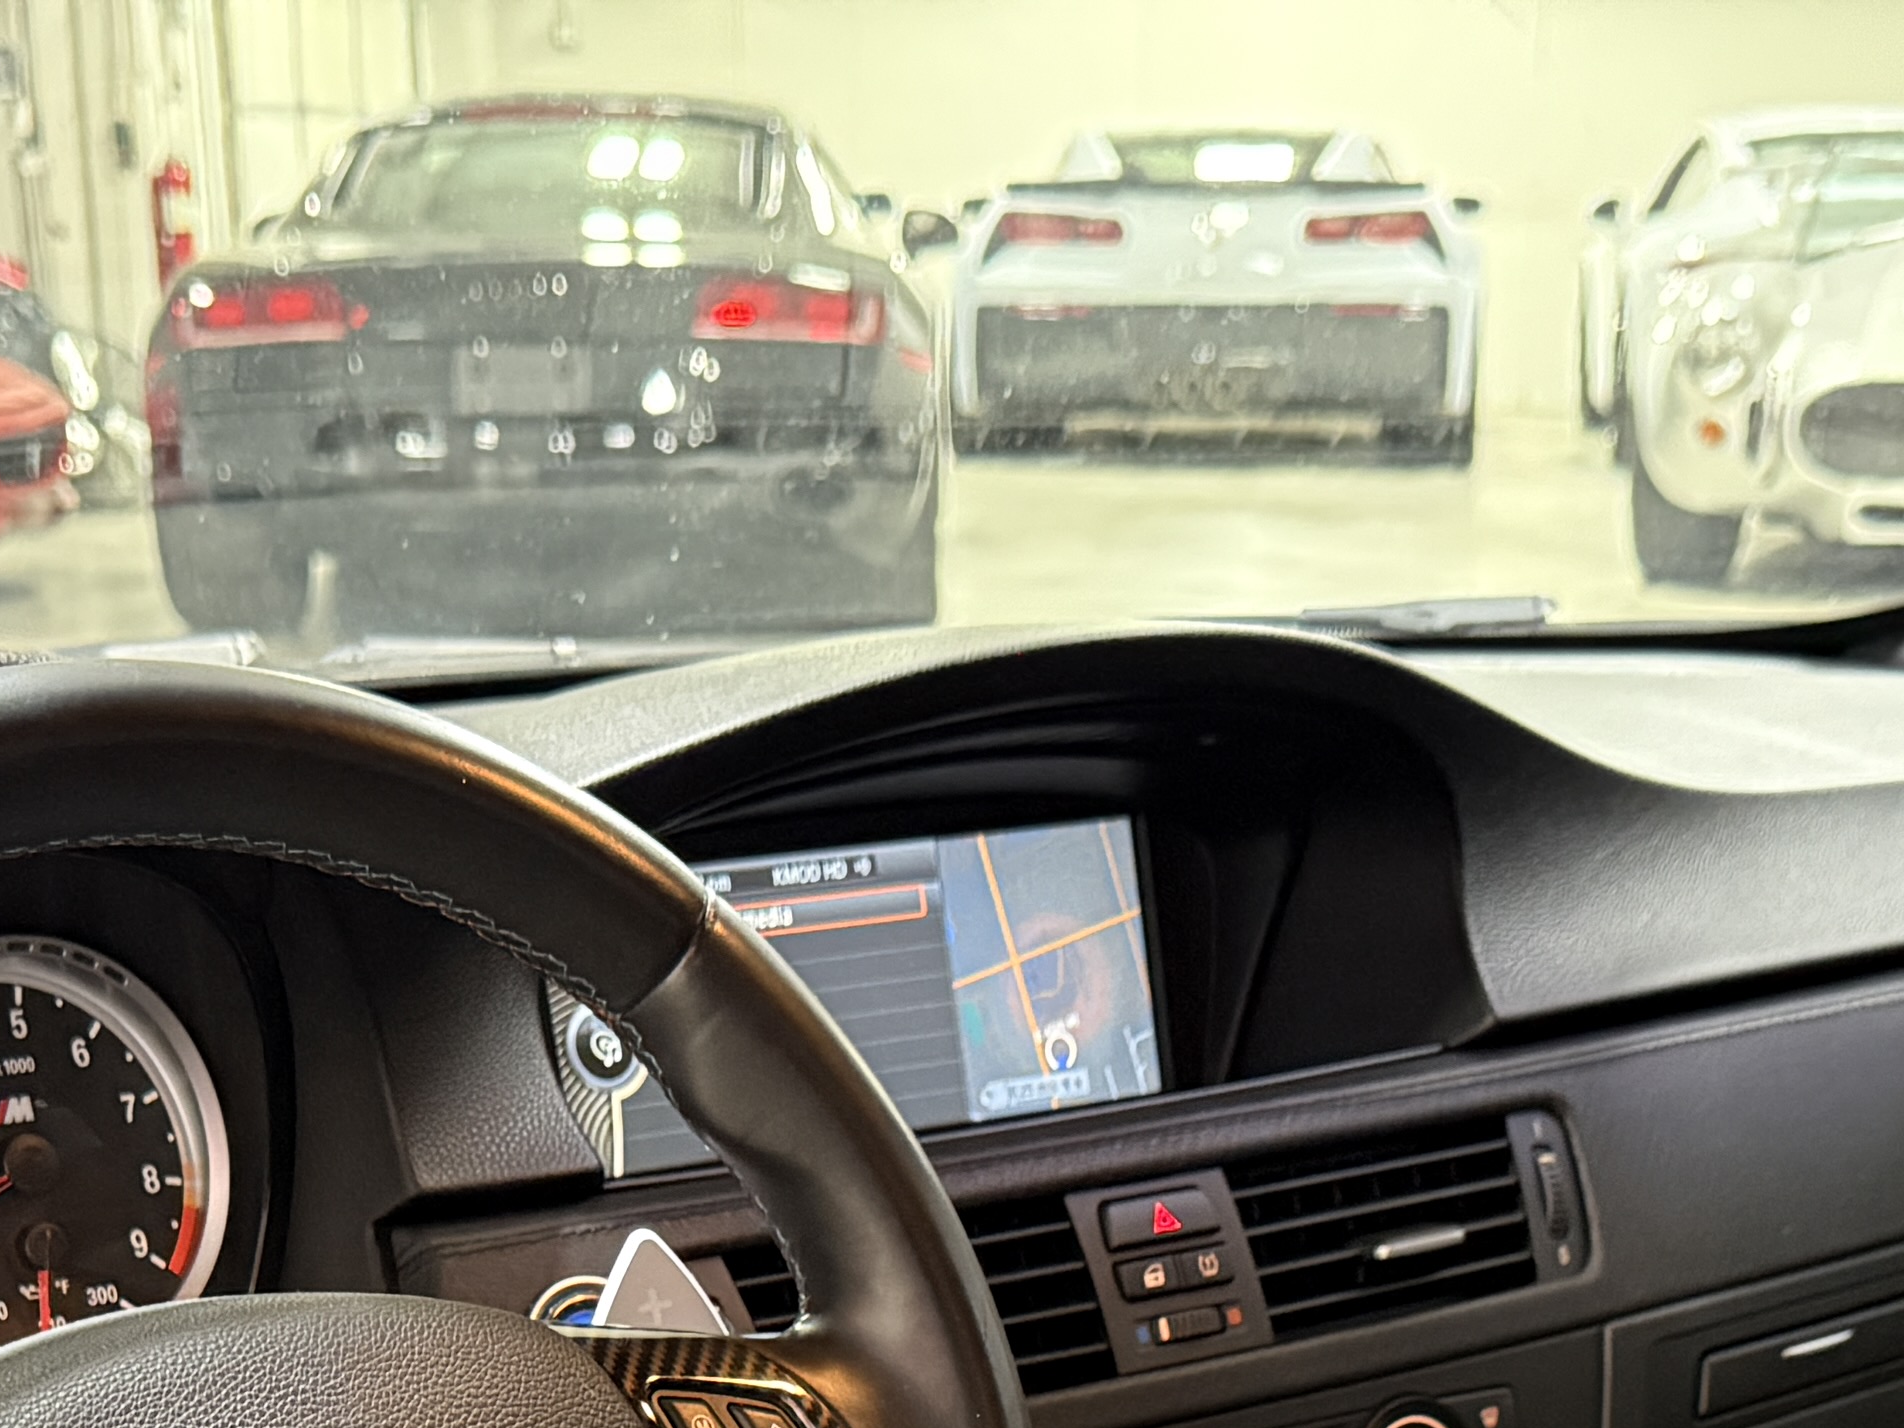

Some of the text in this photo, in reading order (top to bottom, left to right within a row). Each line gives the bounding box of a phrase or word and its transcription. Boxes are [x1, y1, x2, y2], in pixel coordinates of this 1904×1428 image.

[9, 1008, 28, 1040] 5
[71, 1037, 90, 1068] 6
[119, 1093, 136, 1124] 7
[141, 1164, 162, 1195] 8
[129, 1228, 149, 1258] 9
[86, 1284, 119, 1306] 300
